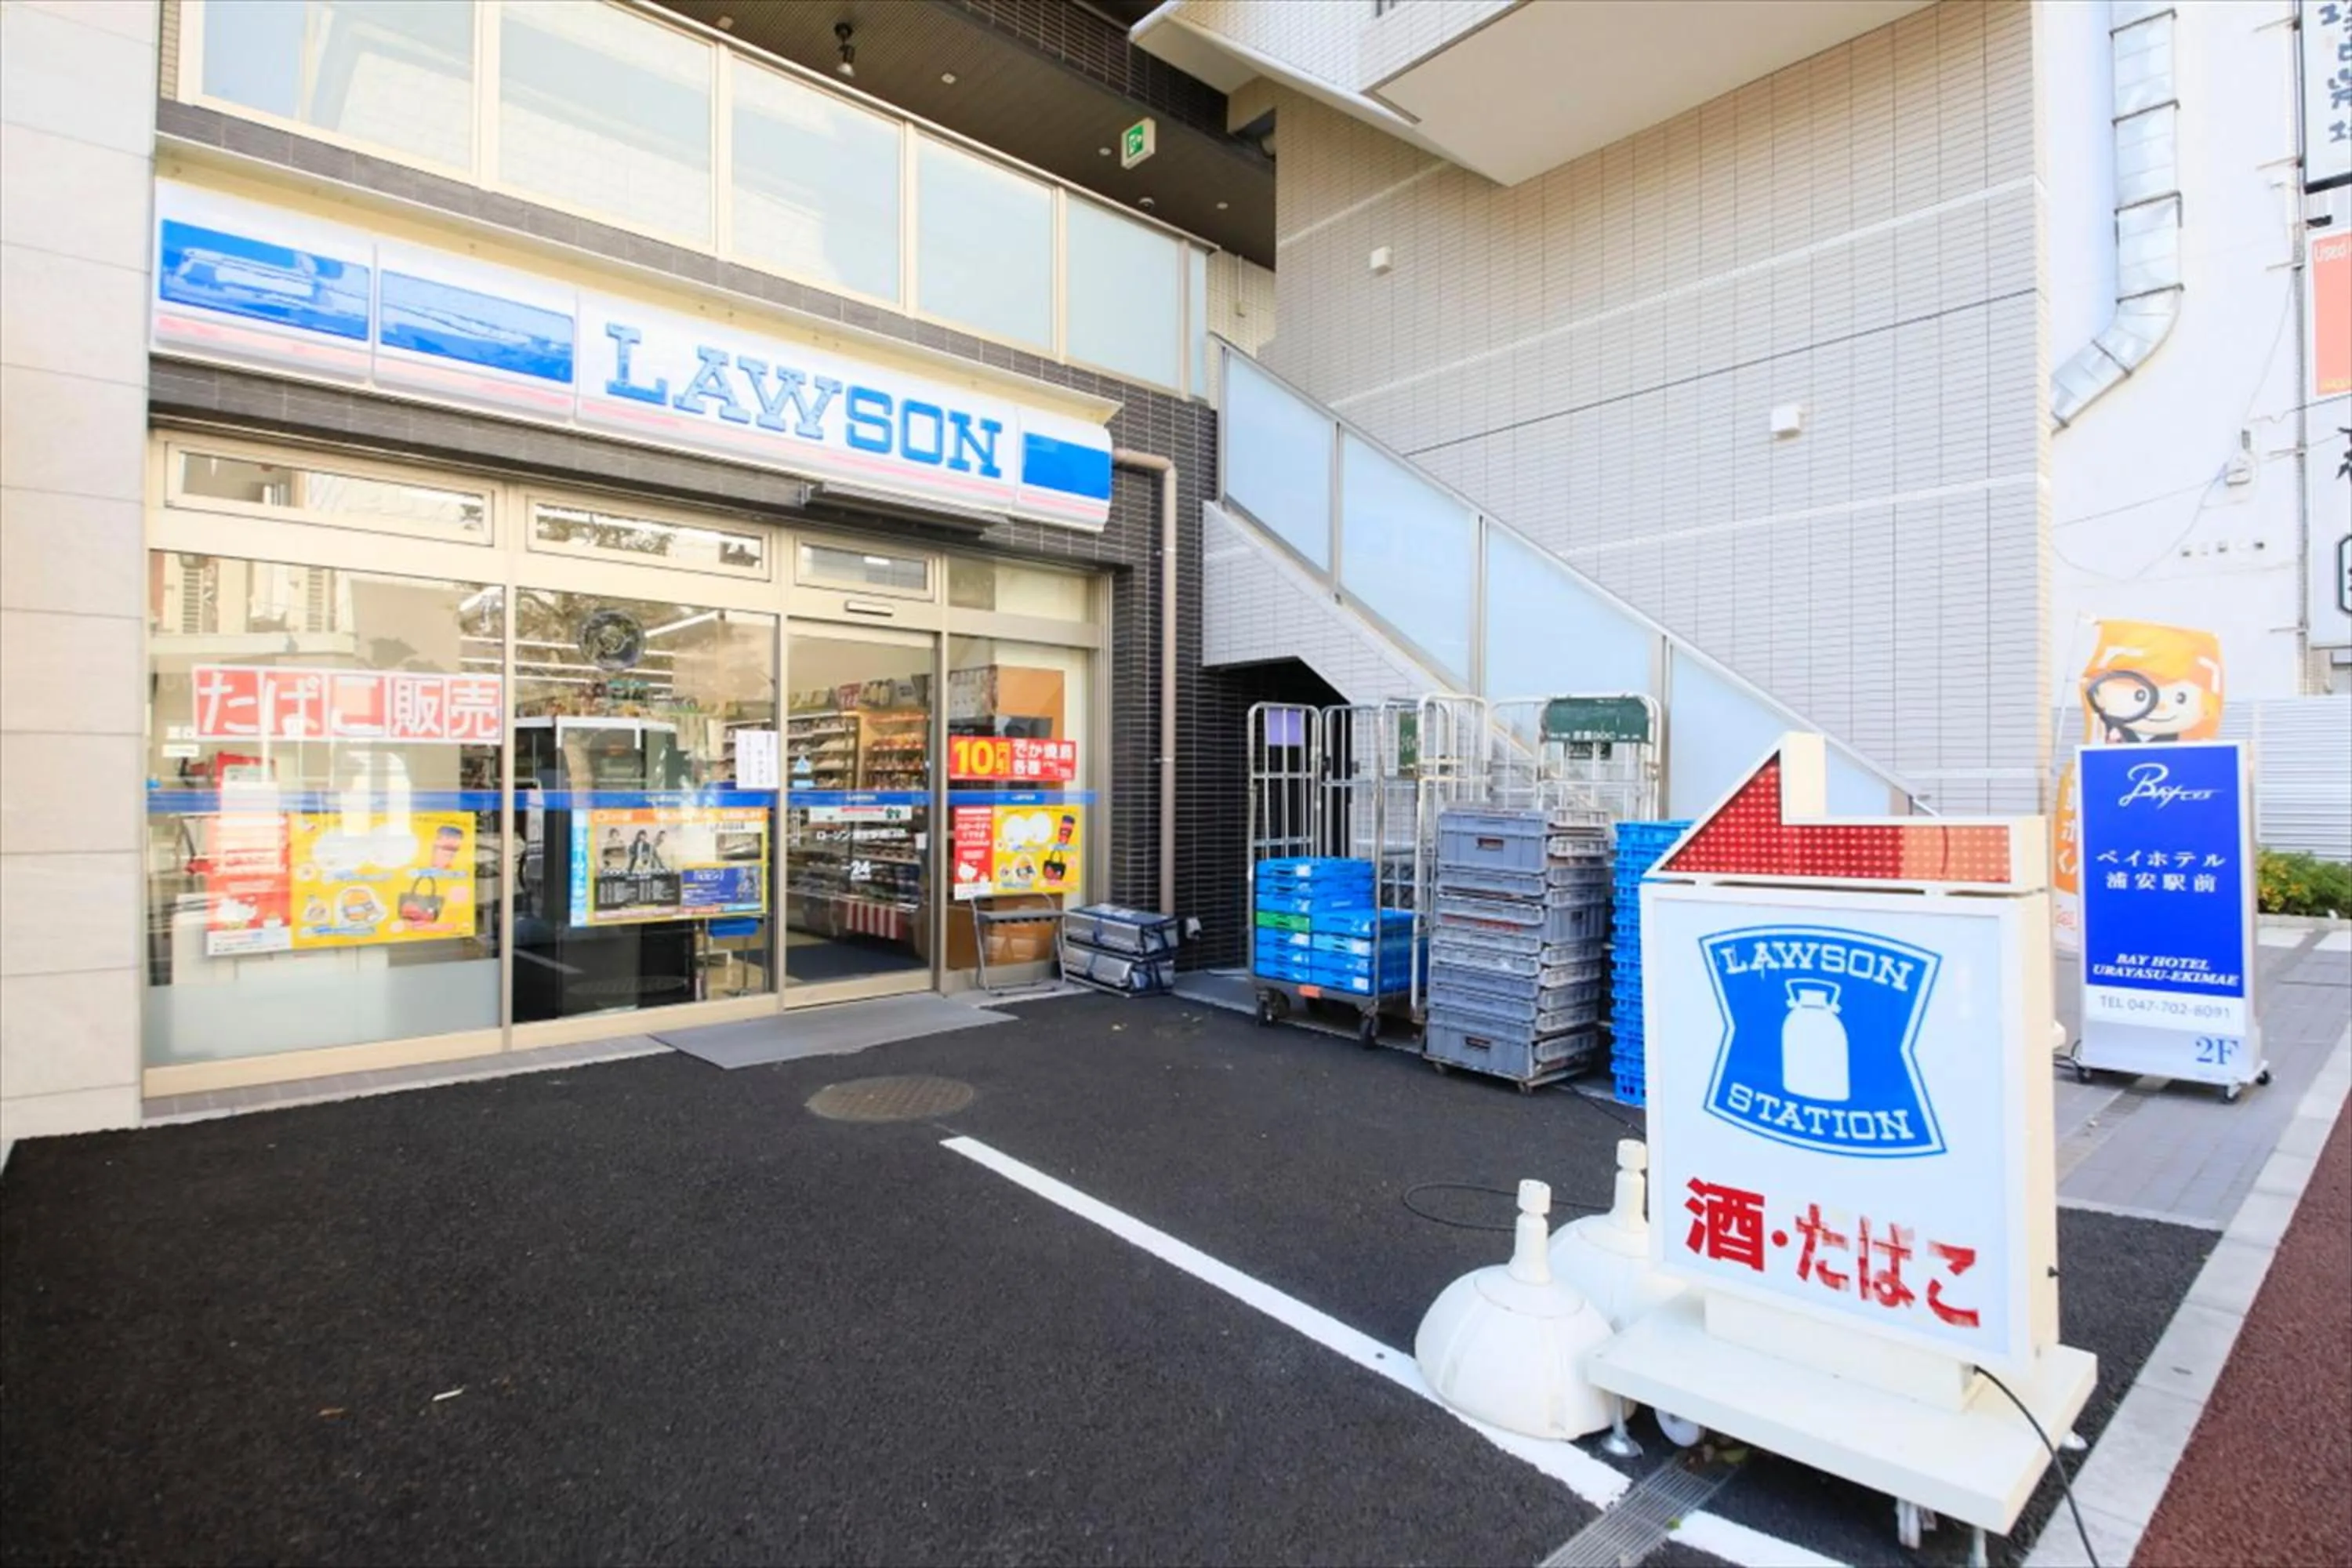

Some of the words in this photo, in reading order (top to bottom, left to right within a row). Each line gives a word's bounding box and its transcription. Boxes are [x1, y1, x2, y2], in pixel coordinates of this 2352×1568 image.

[605, 321, 1004, 480] LAWSON
[198, 671, 499, 739] たばこ販売
[2096, 849, 2227, 869] ベイホテル
[2105, 871, 2217, 893] 浦安駅前
[1720, 942, 1914, 993] LAWSON
[2115, 953, 2150, 966] BAY
[2151, 955, 2211, 971] HOTEL
[2092, 964, 2240, 987] URAYASU-EKIMAE
[2100, 994, 2124, 1009] TEL
[2195, 1036, 2239, 1065] 2F
[1726, 1082, 1916, 1142] STATION
